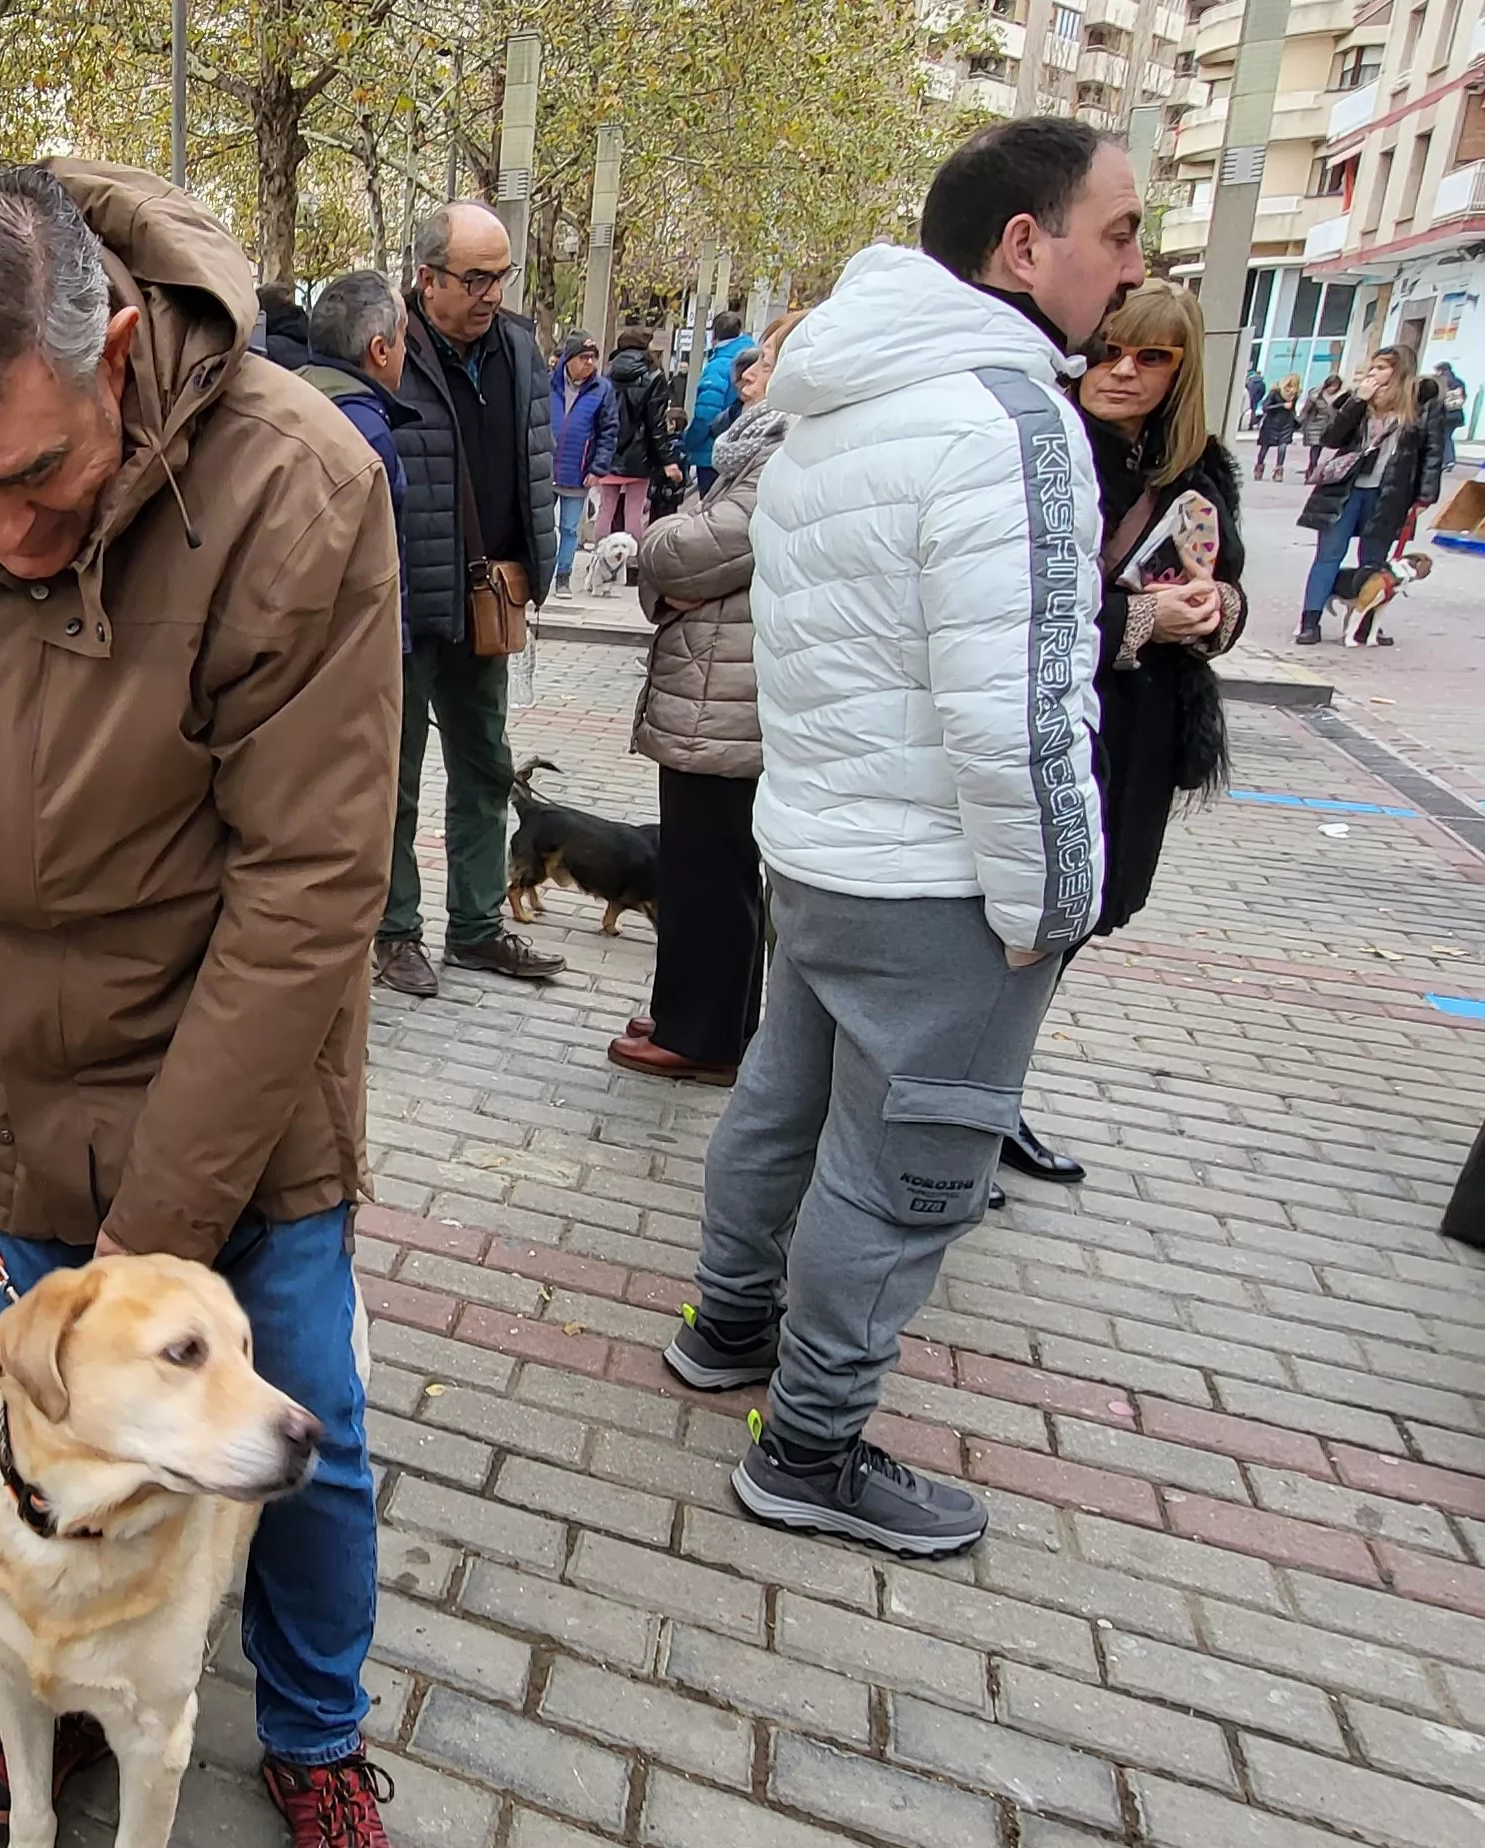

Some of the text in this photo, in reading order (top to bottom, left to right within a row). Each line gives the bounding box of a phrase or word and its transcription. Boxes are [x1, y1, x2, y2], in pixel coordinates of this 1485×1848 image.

[1030, 432, 1091, 942] KRSHI URBAN CONCEPT
